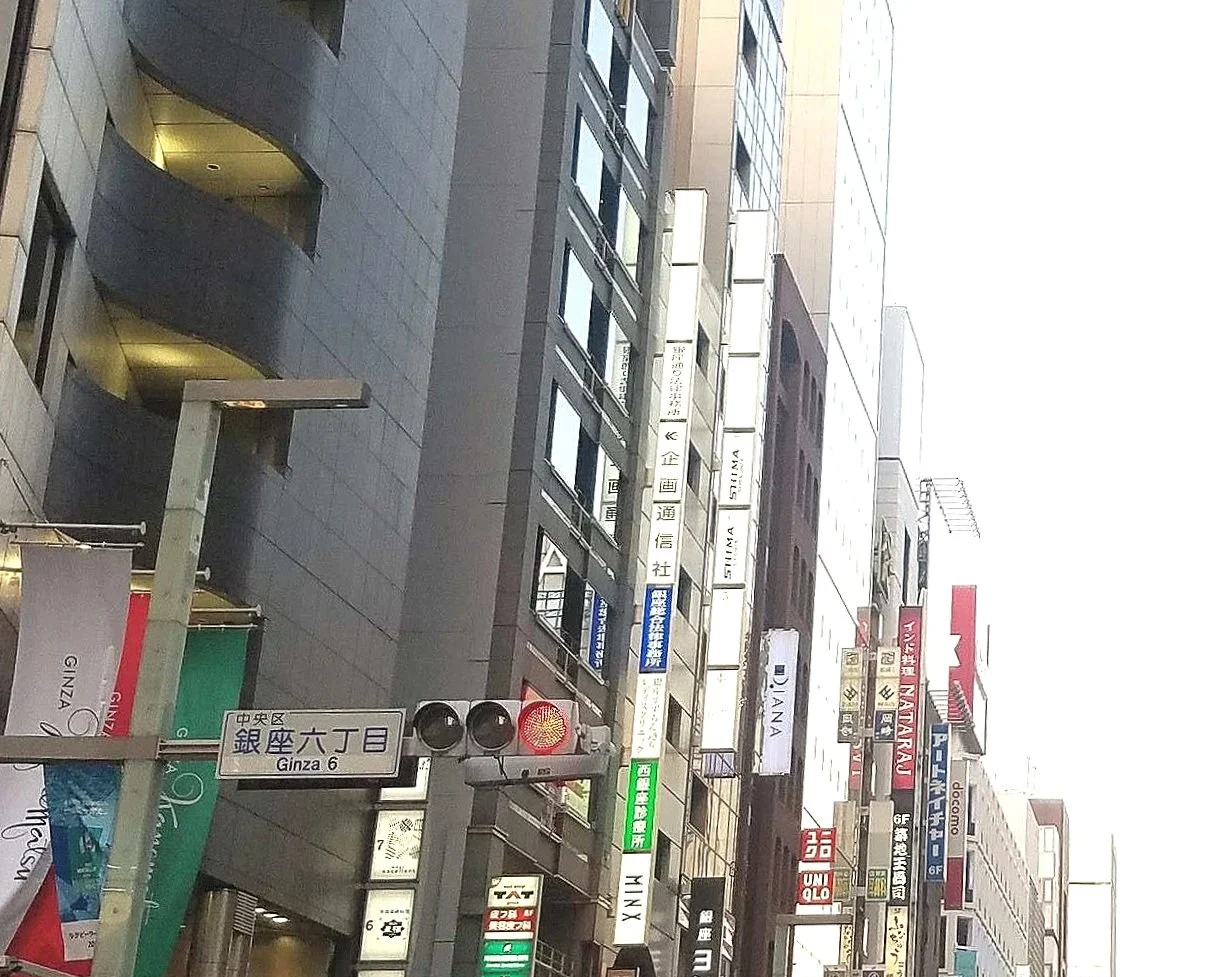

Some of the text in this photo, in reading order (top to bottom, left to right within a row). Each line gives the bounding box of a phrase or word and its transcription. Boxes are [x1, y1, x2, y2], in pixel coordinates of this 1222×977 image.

[652, 450, 680, 577] 企画通信社
[58, 655, 78, 710] GINZA
[236, 712, 285, 726] 中央区
[896, 683, 915, 776] NATARAJ
[232, 727, 388, 755] 銀座六丁目
[276, 756, 339, 772] Ginza 6
[950, 781, 964, 836] docomo
[893, 814, 911, 825] 6F
[377, 839, 385, 851] 7
[928, 865, 943, 876] 6F
[803, 873, 829, 887] UNI
[621, 874, 644, 922] MINX
[803, 887, 830, 903] QLO
[365, 920, 374, 931] 6
